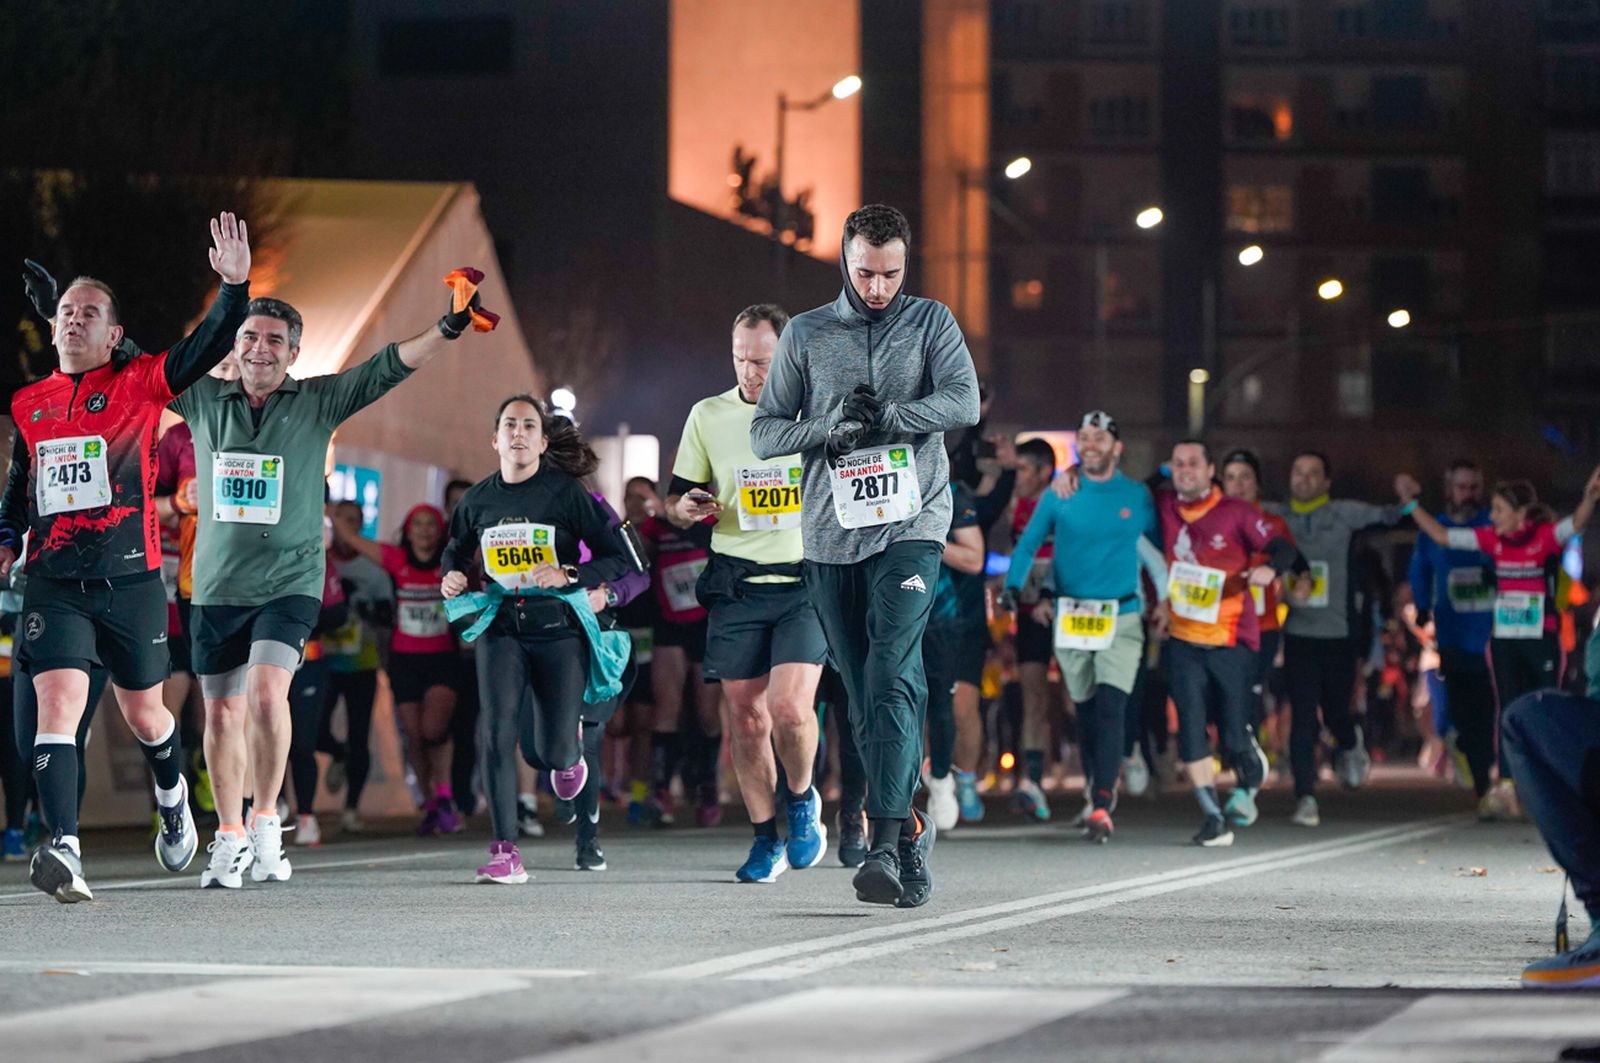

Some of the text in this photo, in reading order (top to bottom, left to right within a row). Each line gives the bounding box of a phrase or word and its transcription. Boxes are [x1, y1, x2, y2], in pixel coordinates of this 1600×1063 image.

[246, 461, 255, 469] DE
[847, 456, 871, 467] NOCHE
[872, 454, 882, 464] DE
[48, 461, 92, 488] 2473
[751, 471, 772, 479] NOCHE
[774, 470, 782, 478] DE
[840, 469, 855, 479] SAN
[857, 464, 884, 476] ANTÓN
[222, 477, 267, 500] 6910
[851, 471, 899, 501] 2877
[749, 486, 799, 508] 12071
[497, 529, 526, 538] NOCHE DE
[497, 546, 544, 567] 5646
